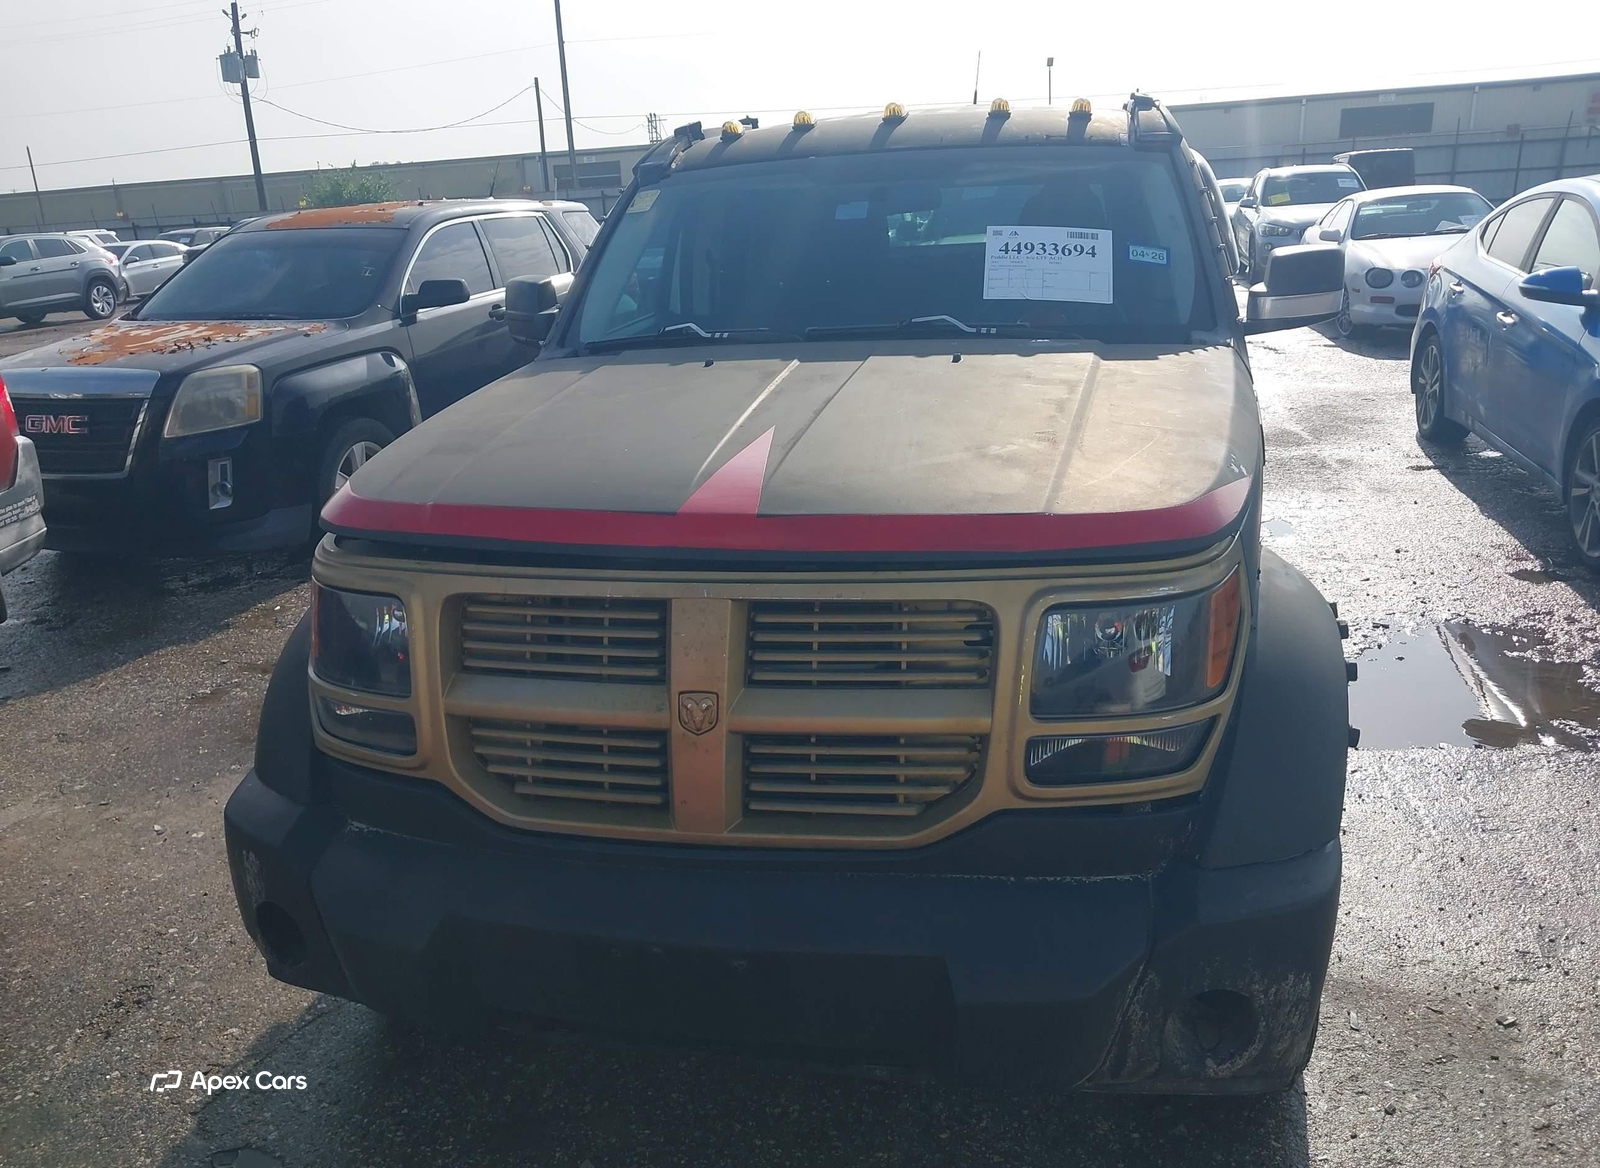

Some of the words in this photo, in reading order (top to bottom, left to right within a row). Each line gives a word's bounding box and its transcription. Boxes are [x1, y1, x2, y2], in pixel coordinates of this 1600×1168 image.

[998, 241, 1097, 258] 44933694
[1131, 249, 1145, 258] 04
[1151, 252, 1165, 261] 26
[25, 414, 88, 434] GMC
